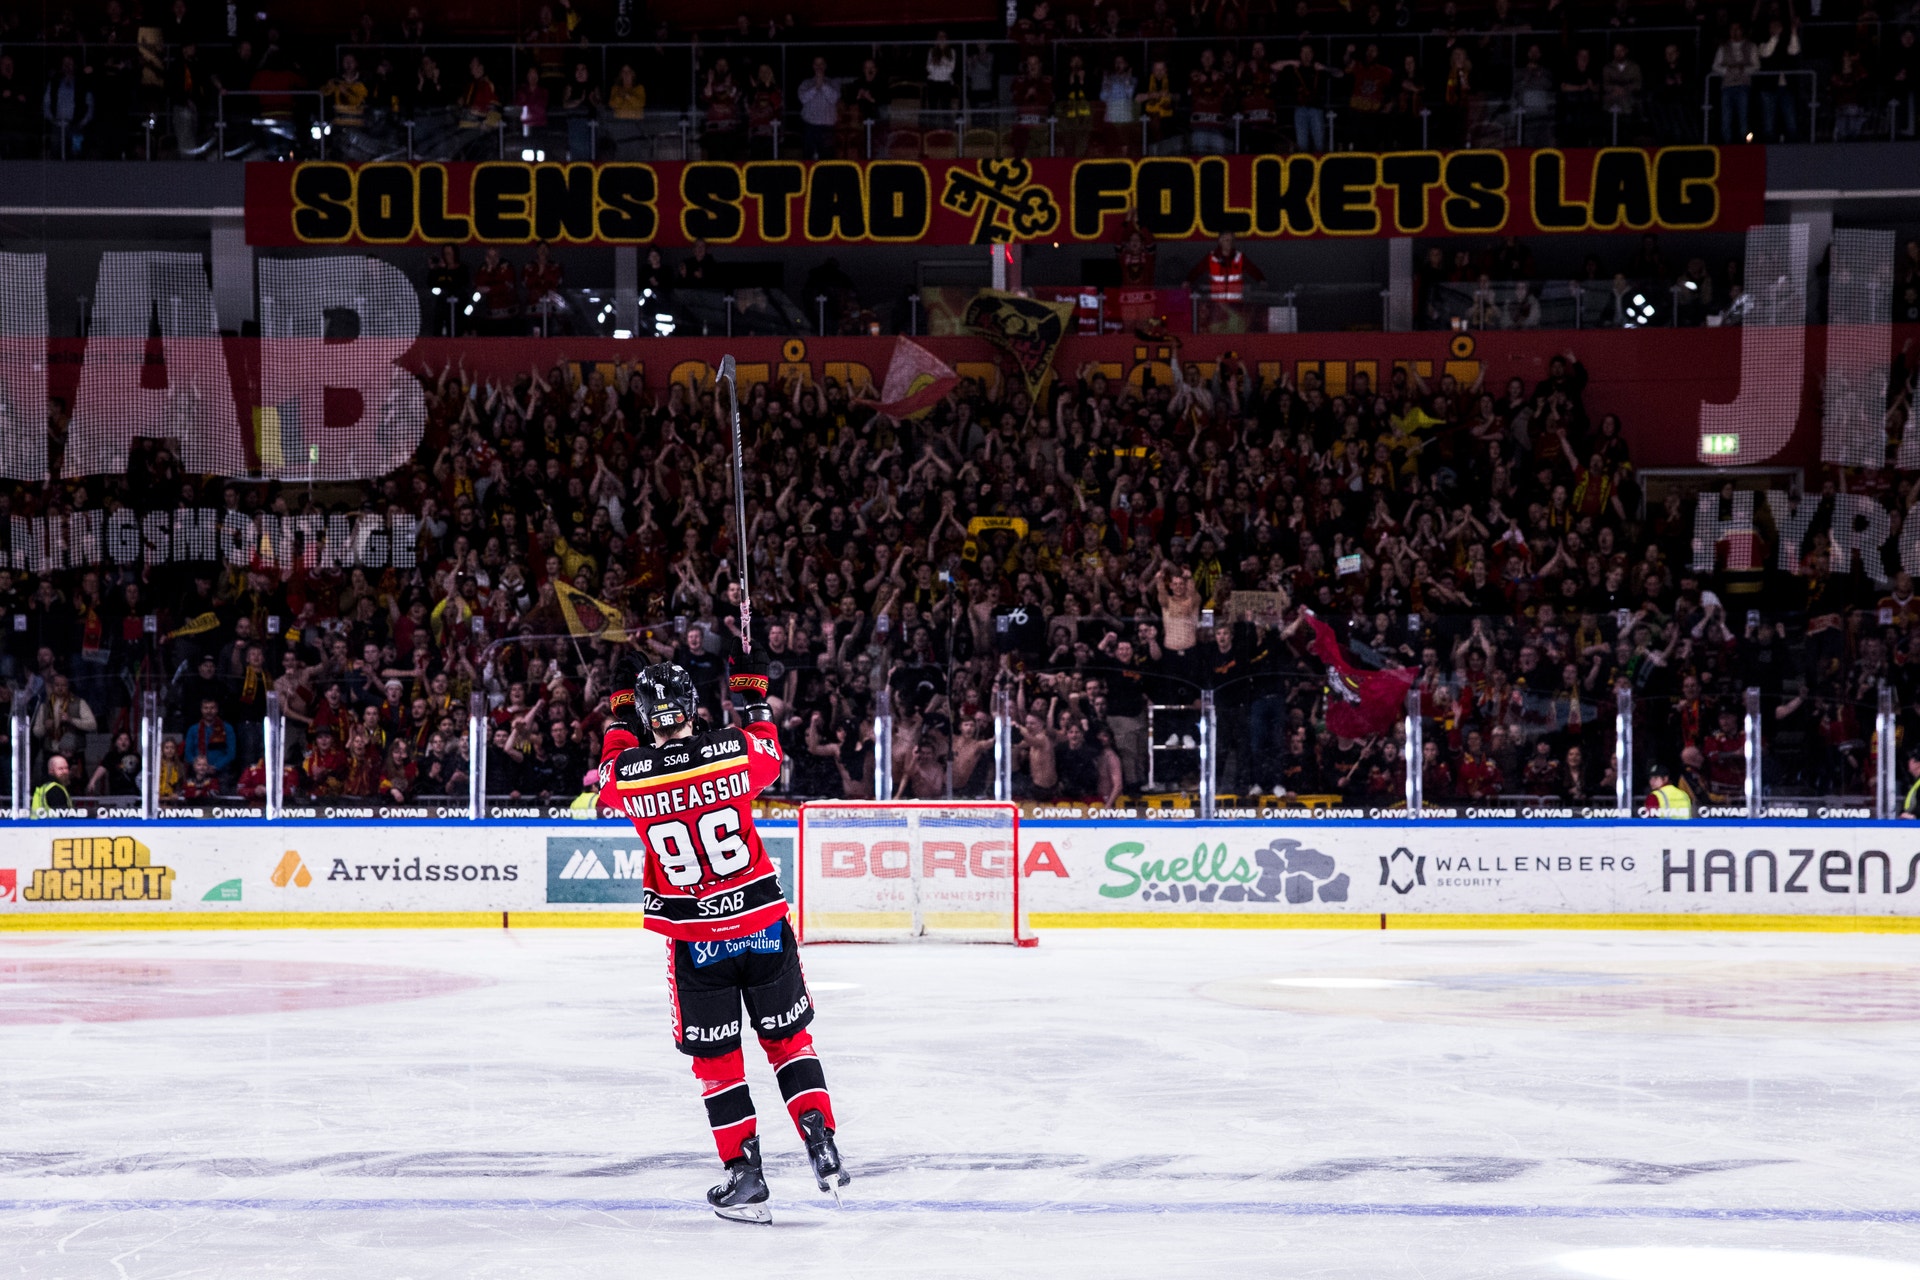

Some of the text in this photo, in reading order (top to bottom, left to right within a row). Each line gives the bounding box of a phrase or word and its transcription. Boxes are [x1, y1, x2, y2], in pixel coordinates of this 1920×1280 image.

[291, 145, 1720, 244] SOLENS STAD FOLKETS LAG
[0, 506, 417, 574] NINGSMONTAGE
[660, 713, 675, 727] 96
[627, 758, 653, 777] LKAB
[663, 752, 690, 767] SSAB
[712, 739, 741, 756] LKAB
[622, 770, 750, 819] ANDREASSON
[166, 807, 204, 818] NYAB
[224, 807, 262, 818] NYAB
[278, 807, 316, 818] NYAB
[336, 807, 373, 818] NYAB
[390, 807, 428, 818] NYAB
[502, 807, 540, 818] NYAB
[1044, 807, 1082, 818] NYAB
[1099, 807, 1137, 818] NYAB
[1157, 807, 1195, 818] NYAB
[1219, 807, 1256, 818] NYAB
[1274, 807, 1312, 818] NYAB
[1326, 807, 1364, 818] NYAB
[1419, 807, 1457, 818] NYAB
[1477, 807, 1516, 818] NYAB
[1534, 807, 1573, 818] NYAB
[1768, 807, 1808, 818] NYAB
[1830, 807, 1871, 818] NYAB
[52, 836, 136, 868] EURO
[645, 806, 751, 888] 96
[820, 841, 1071, 878] BORGA
[1435, 855, 1637, 872] WALLENBERG
[327, 857, 519, 881] Arvidssons
[1098, 841, 1259, 898] Snells
[23, 866, 167, 900] JACKPOT
[1437, 877, 1502, 888] SECURITY
[696, 890, 746, 917] SSAB
[725, 936, 782, 954] Consulting
[776, 994, 809, 1029] LKAB
[699, 1020, 740, 1043] LKAB
